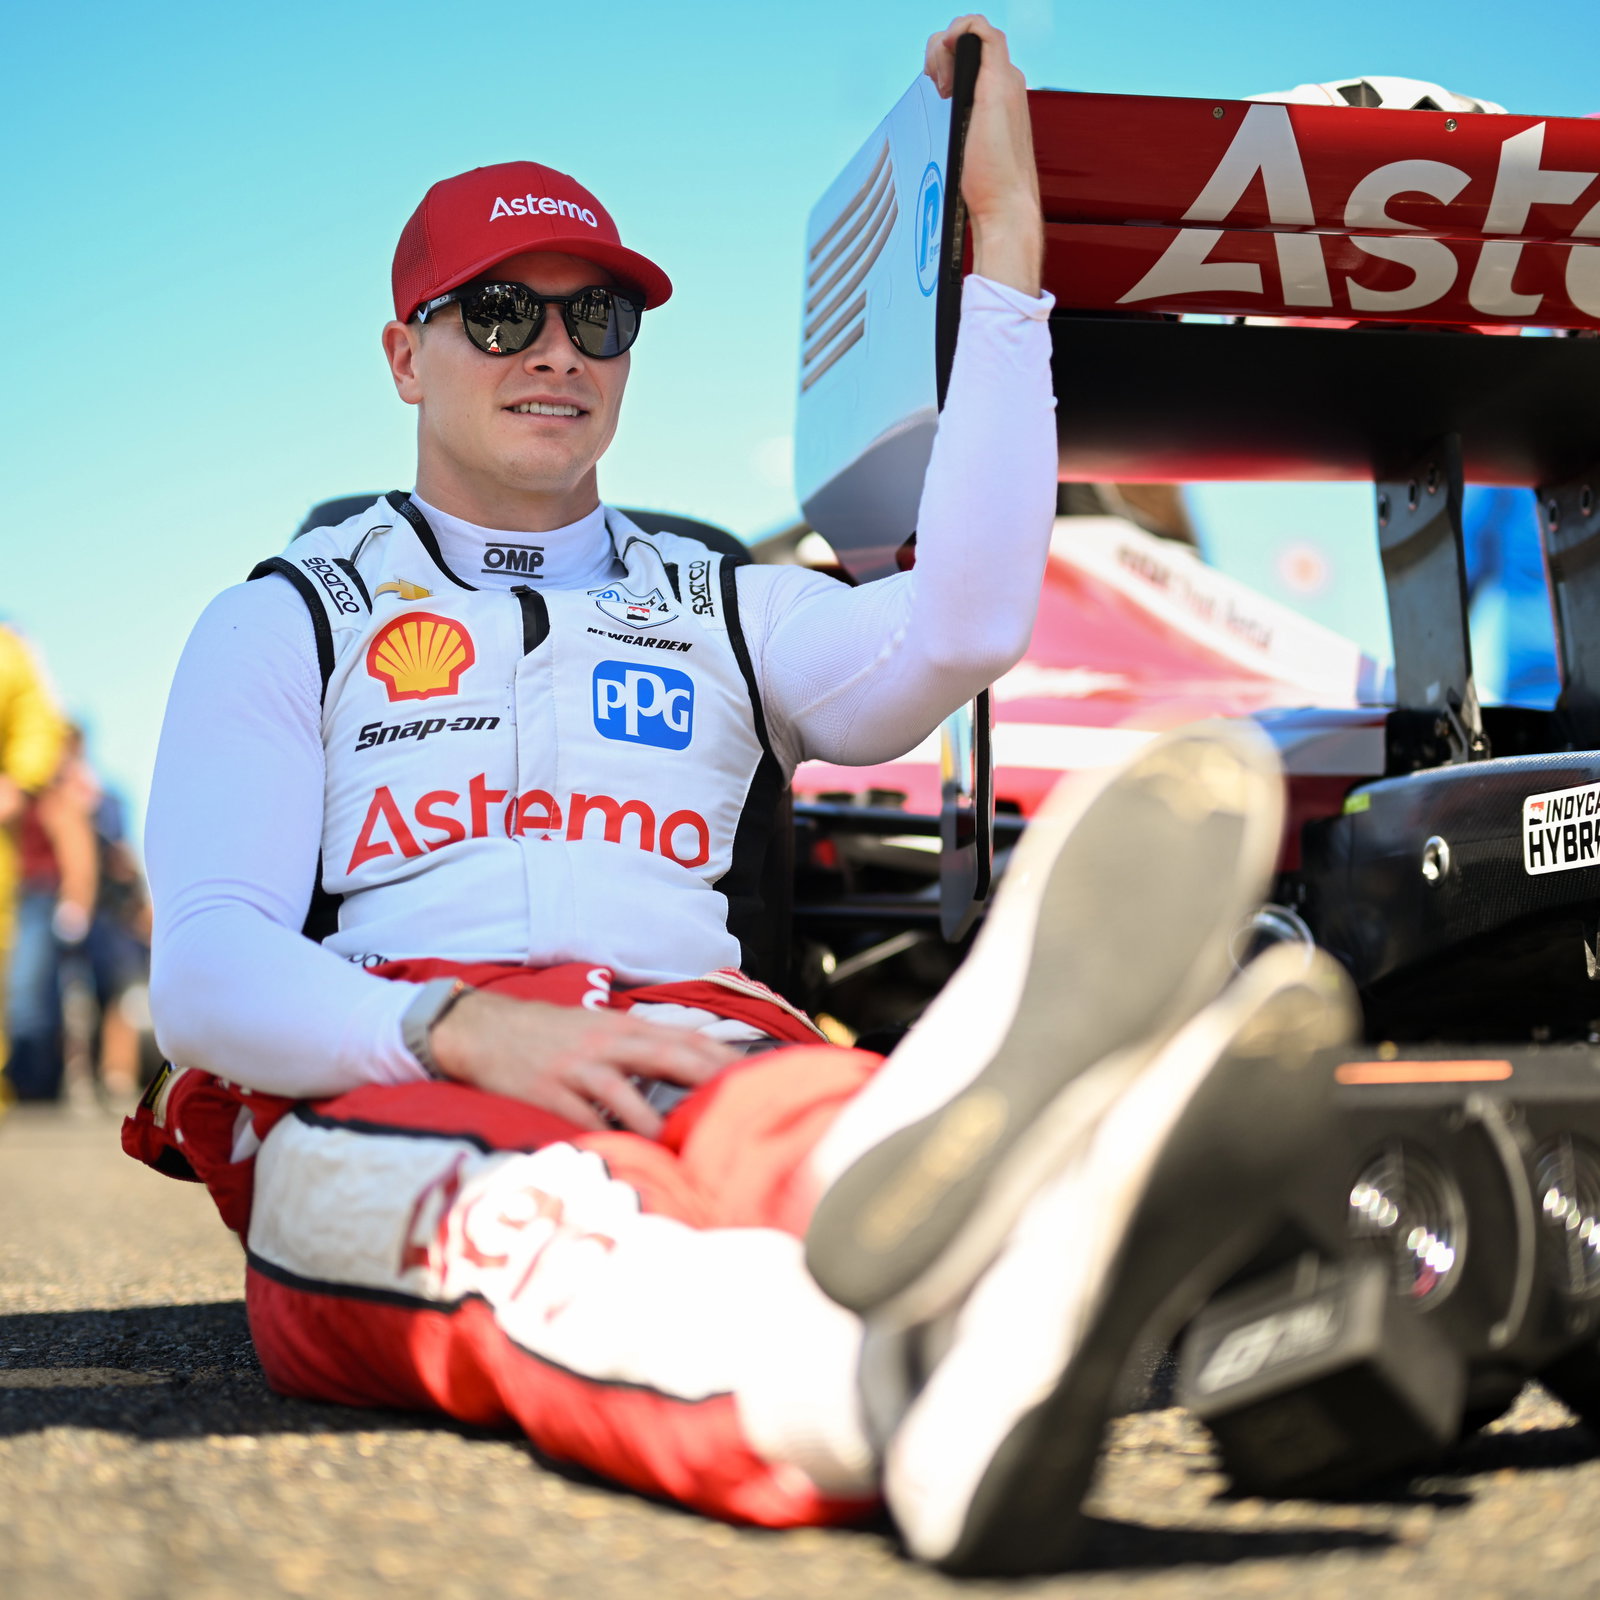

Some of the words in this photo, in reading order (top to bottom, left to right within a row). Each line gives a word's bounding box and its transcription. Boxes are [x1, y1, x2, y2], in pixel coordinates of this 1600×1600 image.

[489, 193, 598, 228] Astemo
[483, 547, 544, 573] OMP
[304, 557, 360, 614] sparco
[587, 627, 693, 652] NEWGARDEN
[597, 669, 690, 737] PPG
[355, 716, 501, 752] Snap-on
[346, 772, 710, 876] Astemo
